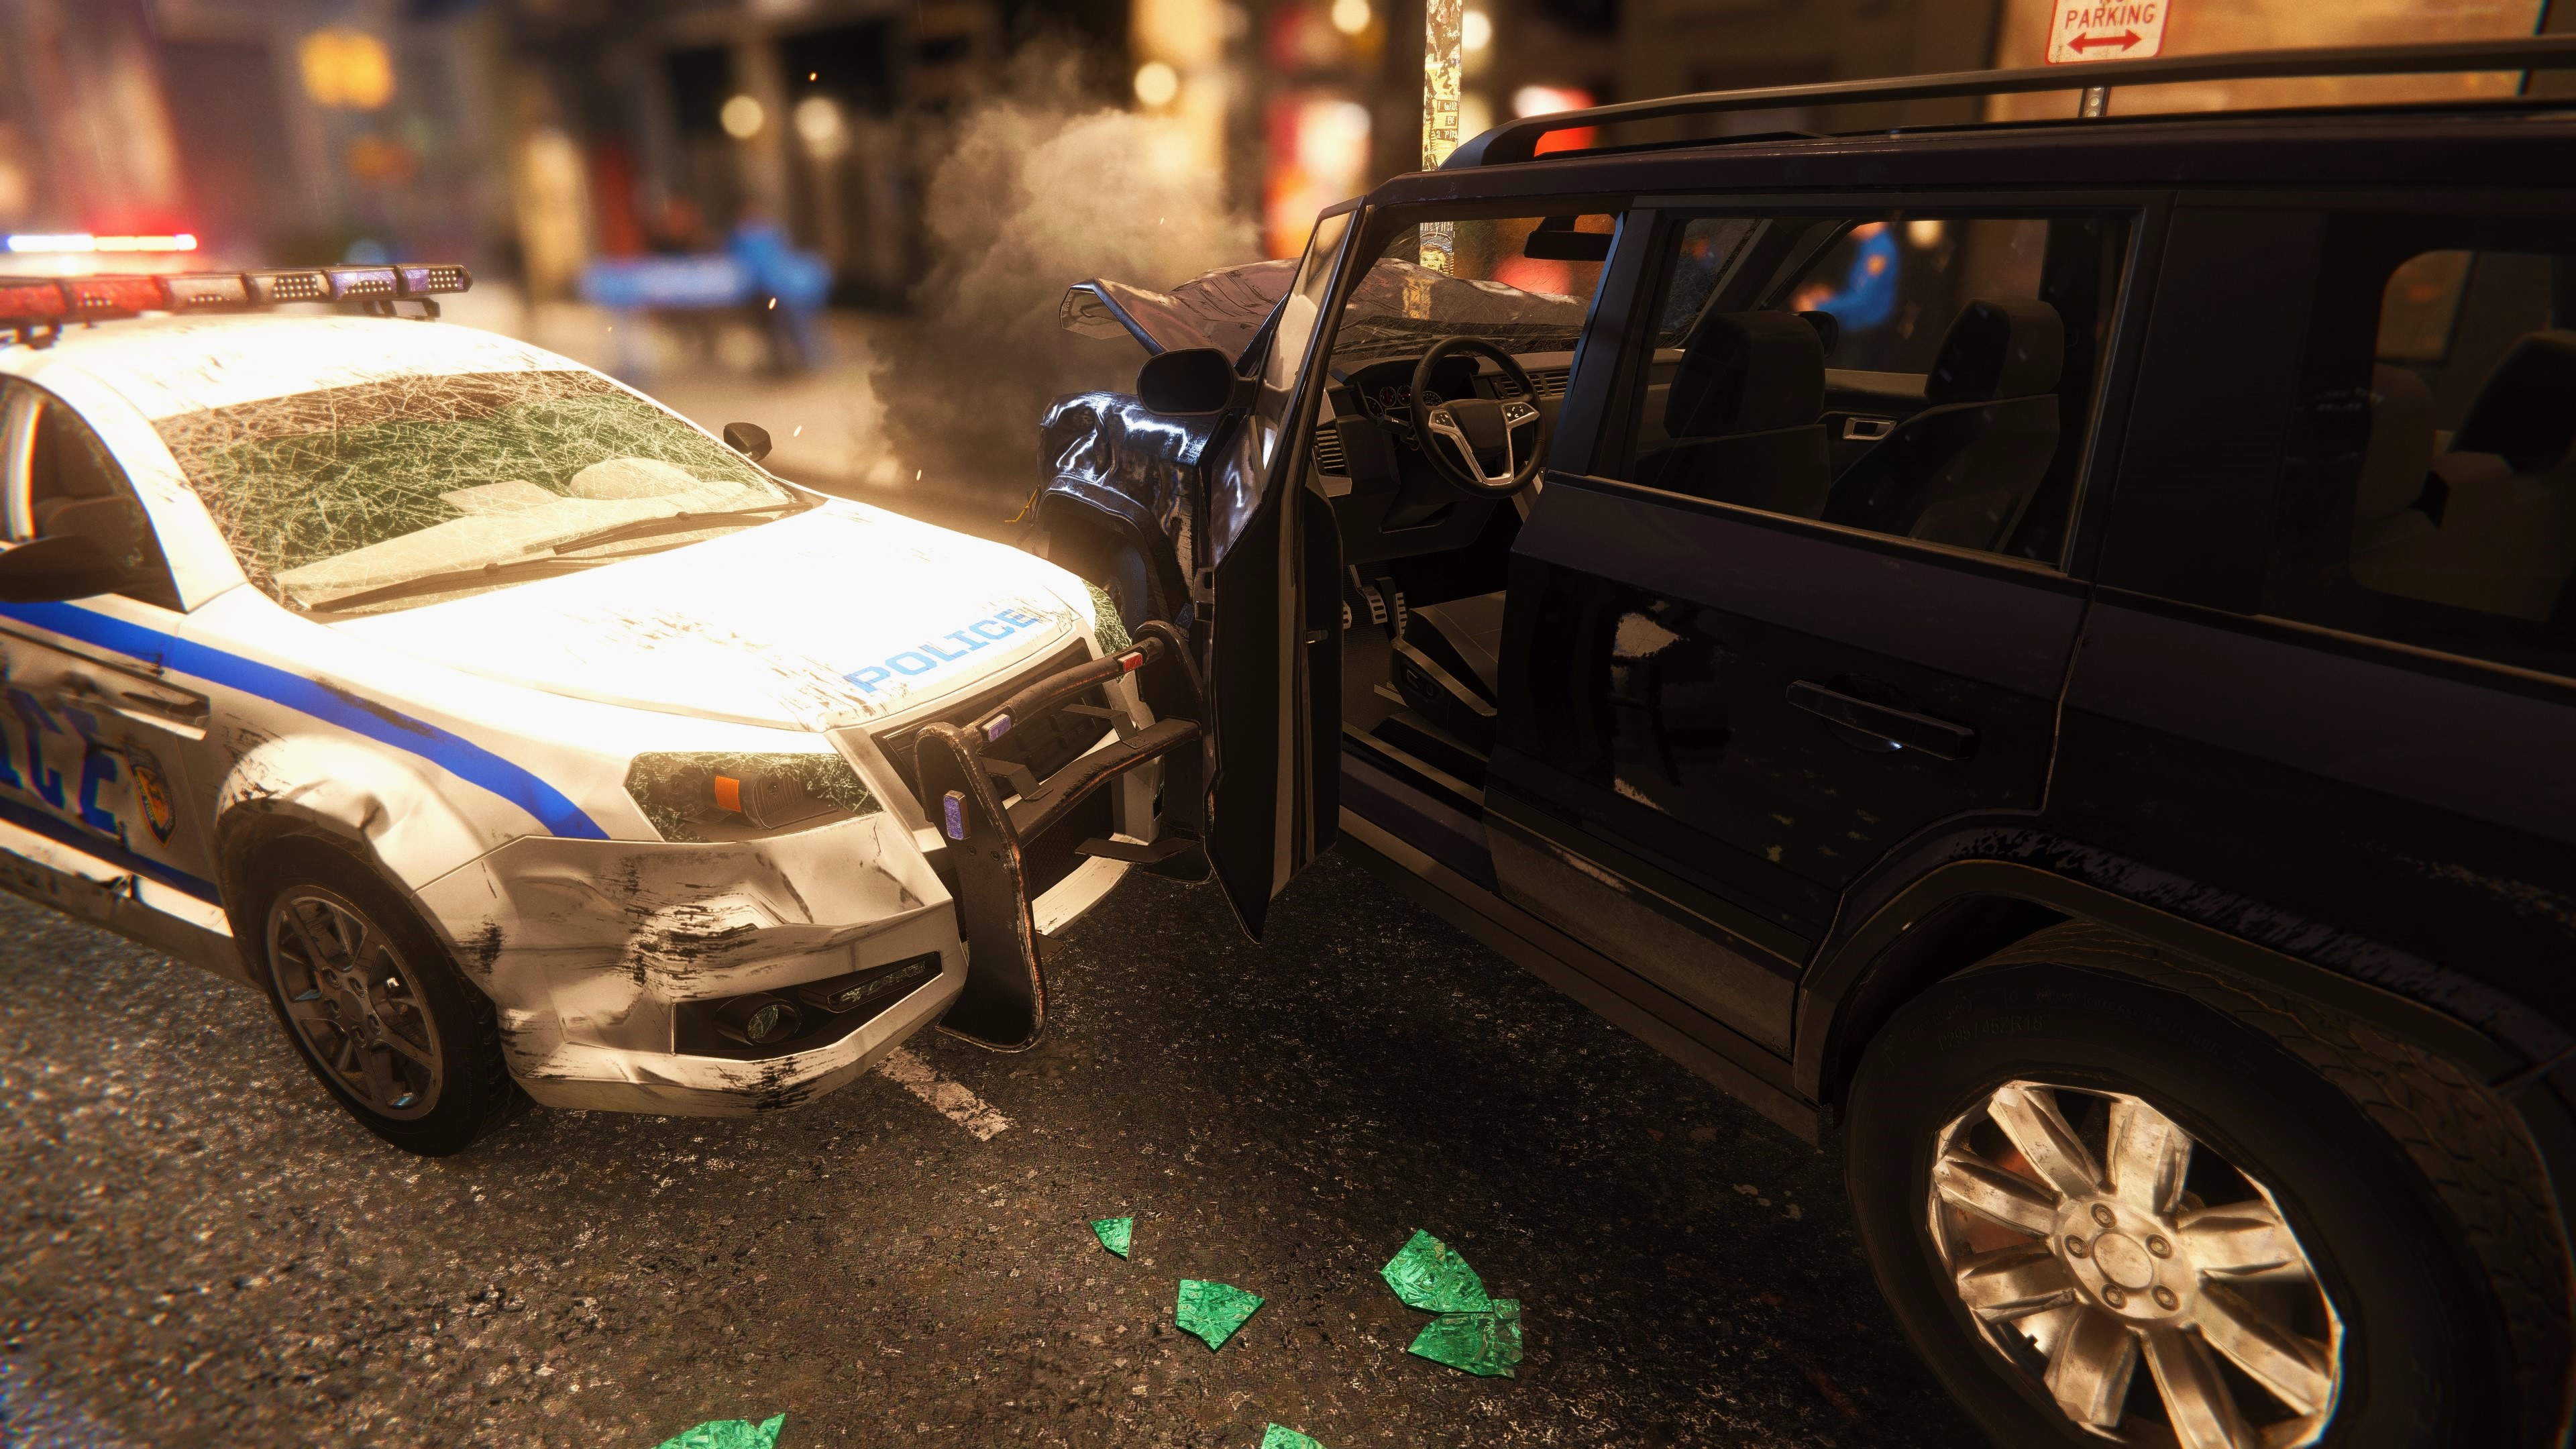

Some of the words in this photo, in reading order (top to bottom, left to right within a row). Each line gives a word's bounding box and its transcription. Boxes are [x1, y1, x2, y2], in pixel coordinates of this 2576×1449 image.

[2064, 3, 2156, 30] PARKING
[843, 608, 1039, 694] POLICE
[144, 798, 156, 820] YORK
